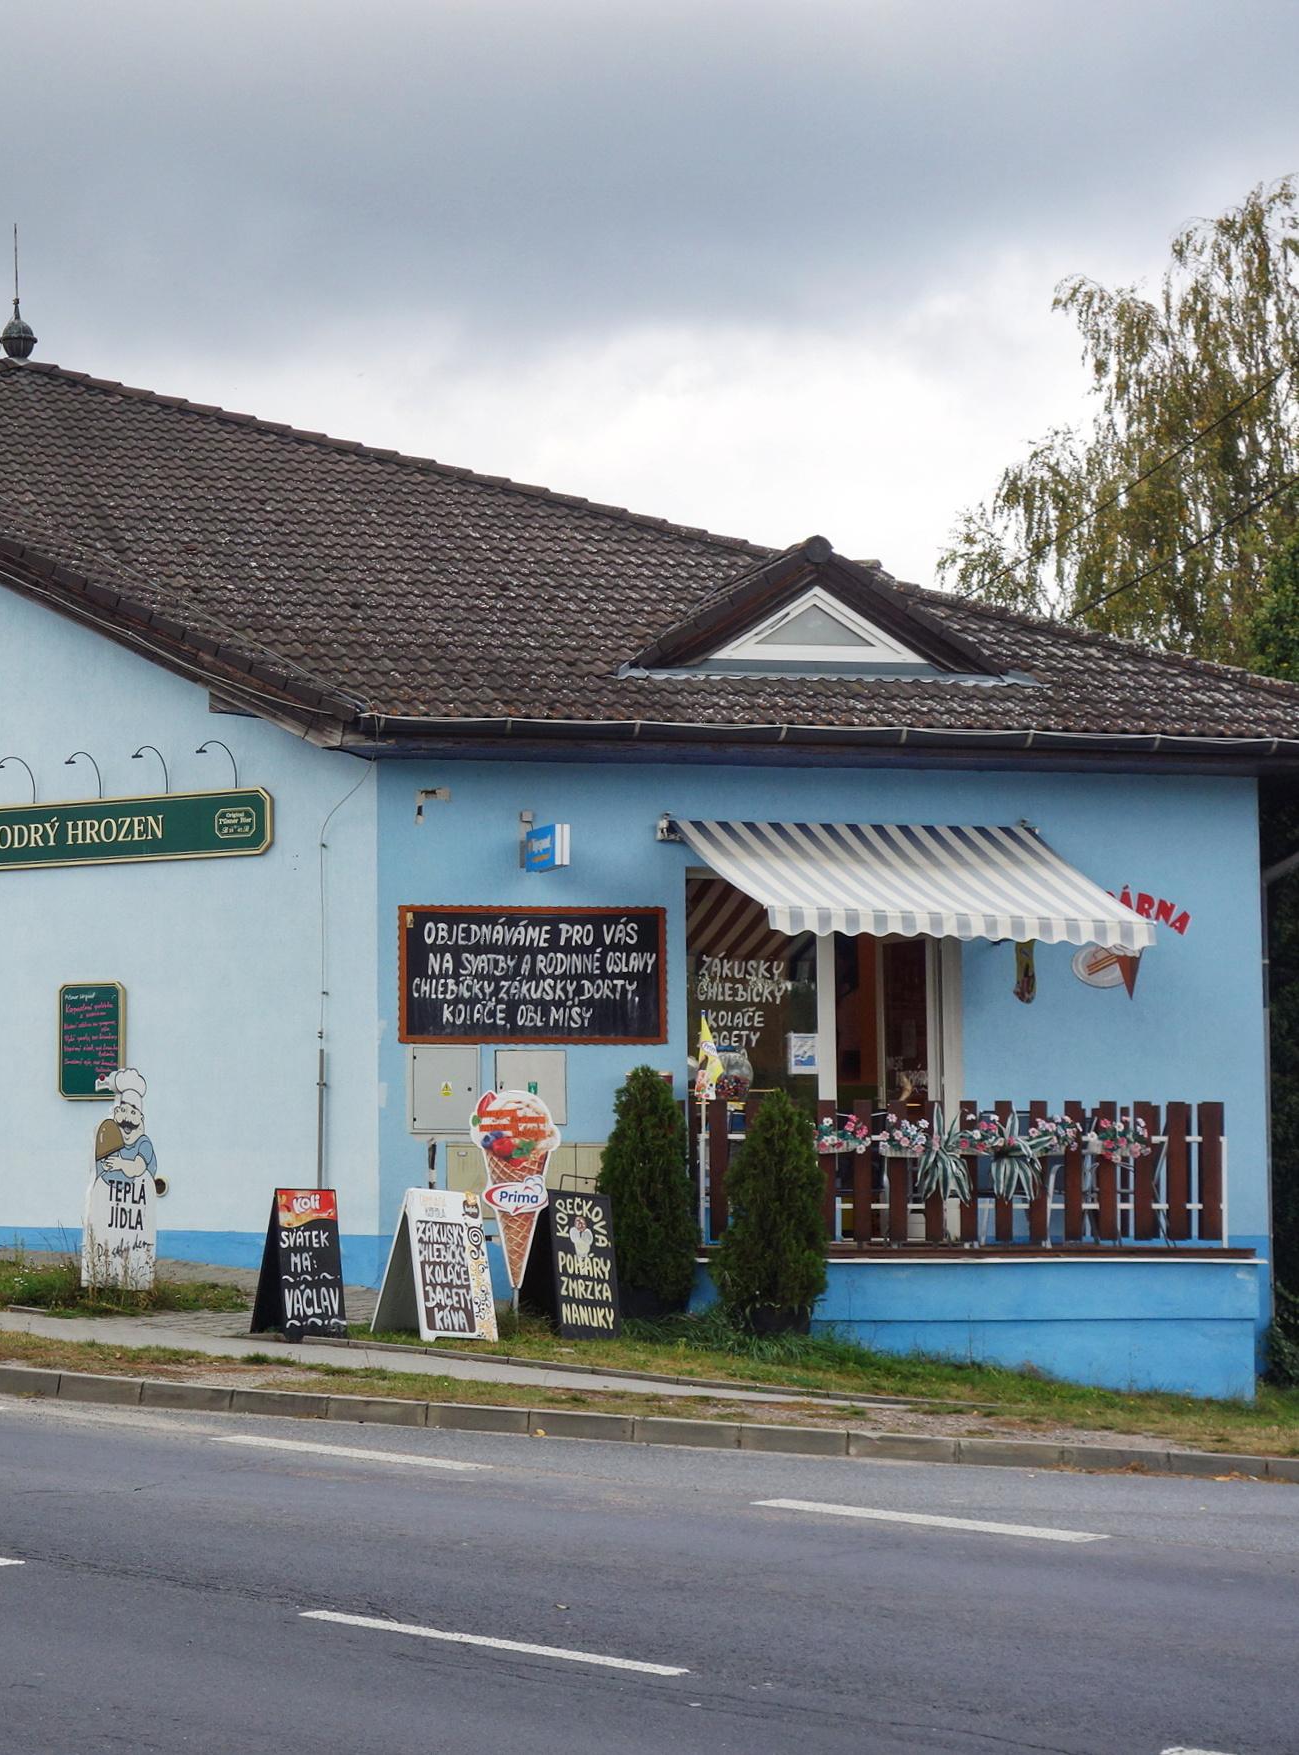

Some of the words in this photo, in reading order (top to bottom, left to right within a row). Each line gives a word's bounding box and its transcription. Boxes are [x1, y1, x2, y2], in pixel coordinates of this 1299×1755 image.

[66, 815, 164, 845] HROZEN
[1106, 884, 1191, 936] ÁRNA
[424, 917, 551, 947] OBJEDNÁVÁME
[559, 923, 594, 946] PRO
[603, 917, 639, 945] VÁS
[428, 952, 454, 975] NA
[459, 953, 518, 976] SVATBY
[521, 954, 531, 976] A
[536, 947, 602, 975] RODINNÉ
[606, 952, 656, 974] OSLAVY
[699, 951, 784, 981] ZÁKUSKY
[550, 1001, 593, 1028] MÍSY
[697, 1030, 761, 1047] AGETY
[108, 1179, 147, 1205] TEPLÁ
[499, 1191, 539, 1204] Prima
[108, 1203, 144, 1231] JÍDLA
[556, 1198, 611, 1248] KOPEČKOVÁ
[280, 1227, 330, 1249] SVÁTEK
[416, 1221, 465, 1247] ZÁKUSKY
[558, 1251, 611, 1280] POHÁRY
[284, 1284, 339, 1319] VÁCLAV
[425, 1285, 473, 1310] BAGETY
[561, 1277, 612, 1302] ZMRZKA
[434, 1305, 469, 1332] KÁVA
[562, 1303, 614, 1330] NANUKY
